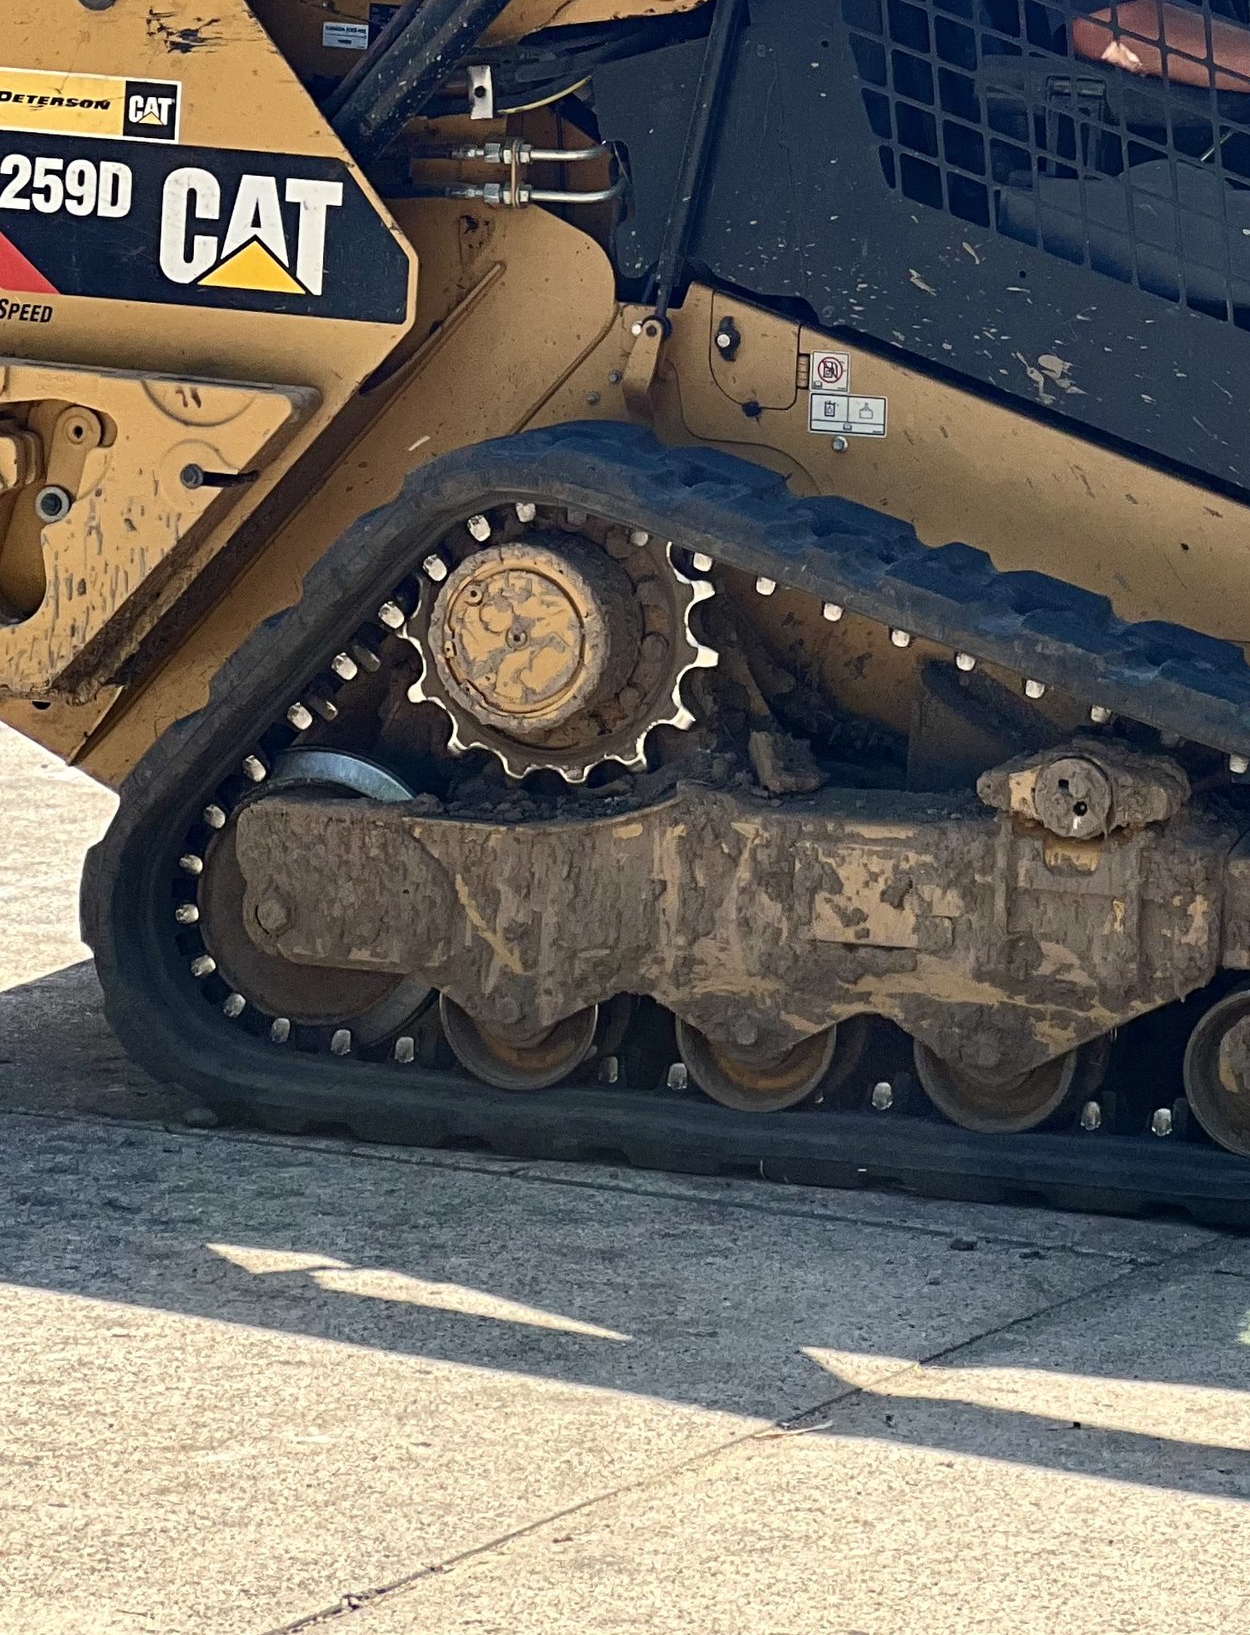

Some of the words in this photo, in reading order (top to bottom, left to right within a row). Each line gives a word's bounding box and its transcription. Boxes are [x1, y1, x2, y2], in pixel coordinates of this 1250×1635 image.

[128, 94, 173, 126] CAT
[0, 153, 133, 218] 259D
[159, 166, 344, 296] CAT
[0, 298, 53, 323] SPEED
